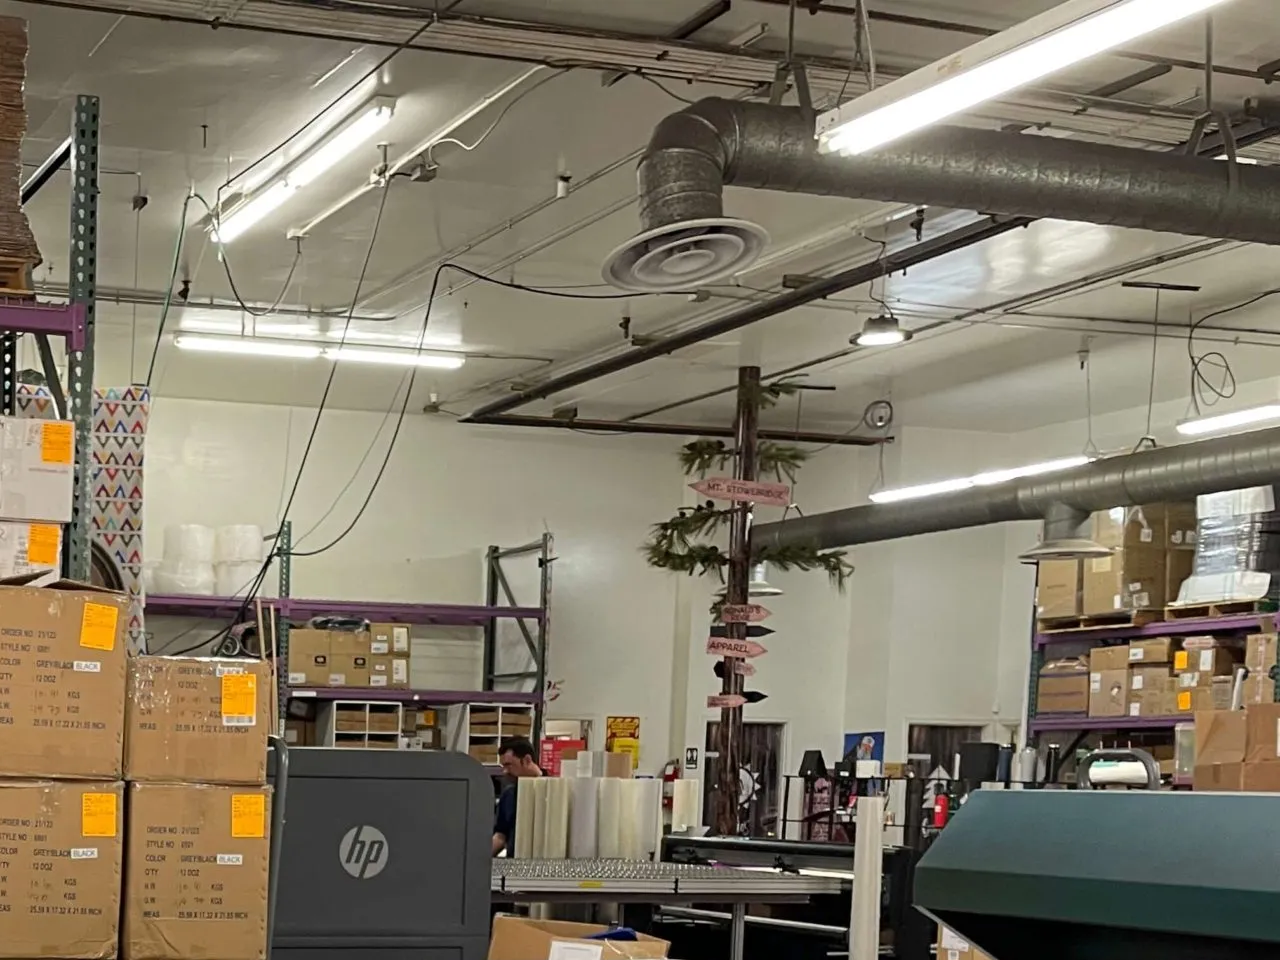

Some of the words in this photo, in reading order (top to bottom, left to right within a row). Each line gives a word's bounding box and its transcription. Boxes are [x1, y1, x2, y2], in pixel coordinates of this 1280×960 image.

[709, 641, 749, 653] APPAREL
[0, 657, 21, 665] COLOR
[147, 840, 164, 848] STYLE
[73, 849, 95, 857] BLACK
[345, 825, 385, 879] hp
[145, 854, 166, 862] COLOR
